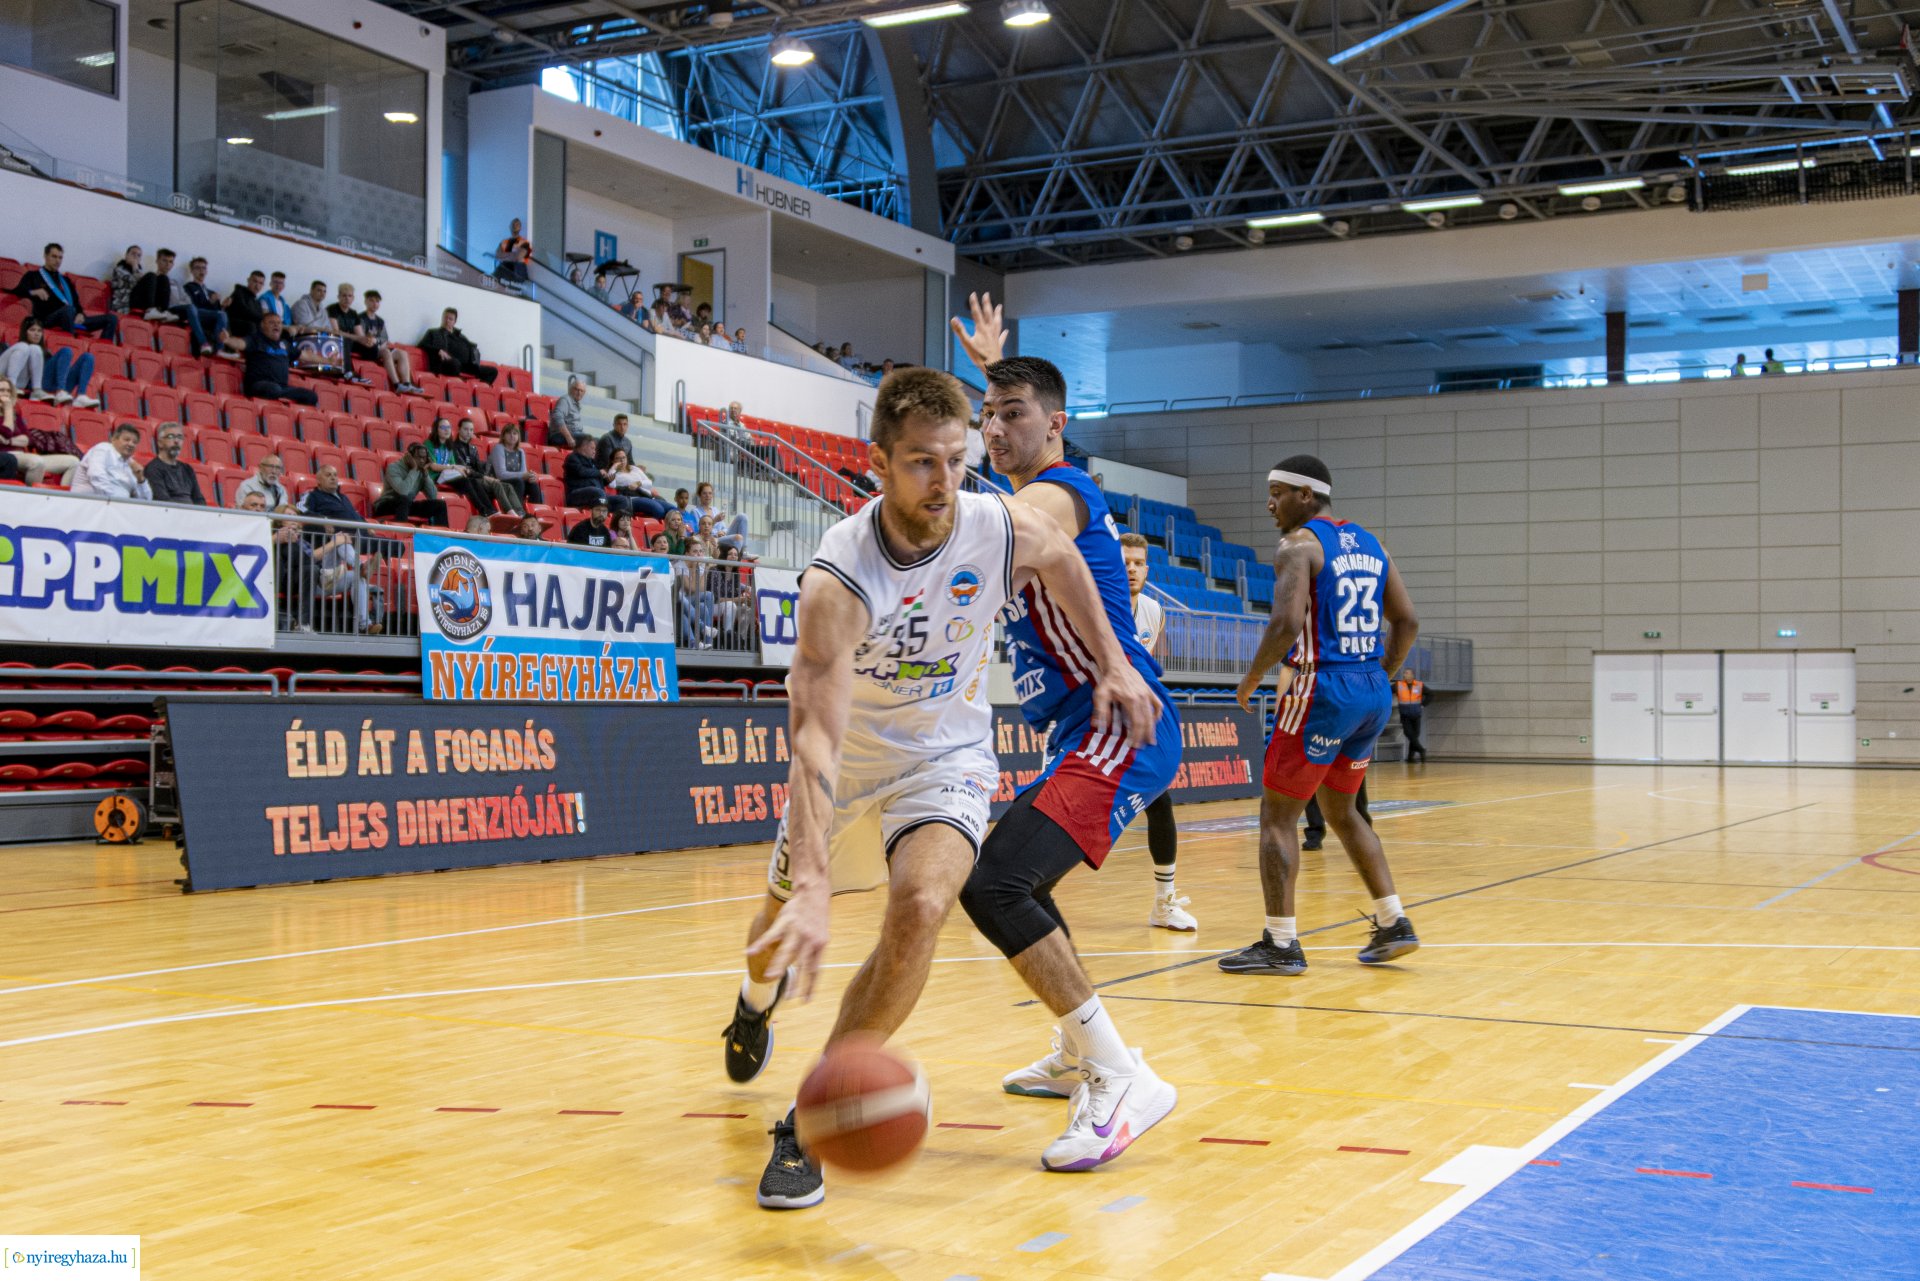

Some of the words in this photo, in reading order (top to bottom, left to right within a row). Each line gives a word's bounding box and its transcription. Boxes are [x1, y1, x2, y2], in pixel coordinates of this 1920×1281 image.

[755, 183, 811, 218] HÜBNER
[503, 568, 657, 634] HAJRÁ
[1338, 577, 1380, 633] 23
[1341, 636, 1377, 654] PAKS
[429, 637, 669, 701] NYÍREGYHÁZA!
[286, 719, 348, 778] ÉLD
[358, 719, 396, 776] ÁT
[406, 729, 428, 774] A
[434, 719, 557, 773] FOGADÁS
[698, 719, 738, 765] ÉLD
[745, 719, 768, 763] ÁT
[775, 727, 790, 763] A
[997, 717, 1014, 754] ÁT
[1018, 723, 1029, 753] A
[1188, 722, 1197, 748] A
[1196, 716, 1239, 747] FOGADÁS
[689, 783, 768, 825] TELJES
[940, 785, 976, 799] ALAN
[265, 801, 388, 856] TELJES
[396, 782, 587, 847] DIMENZIÓJÁT!
[959, 812, 980, 832] JAKO
